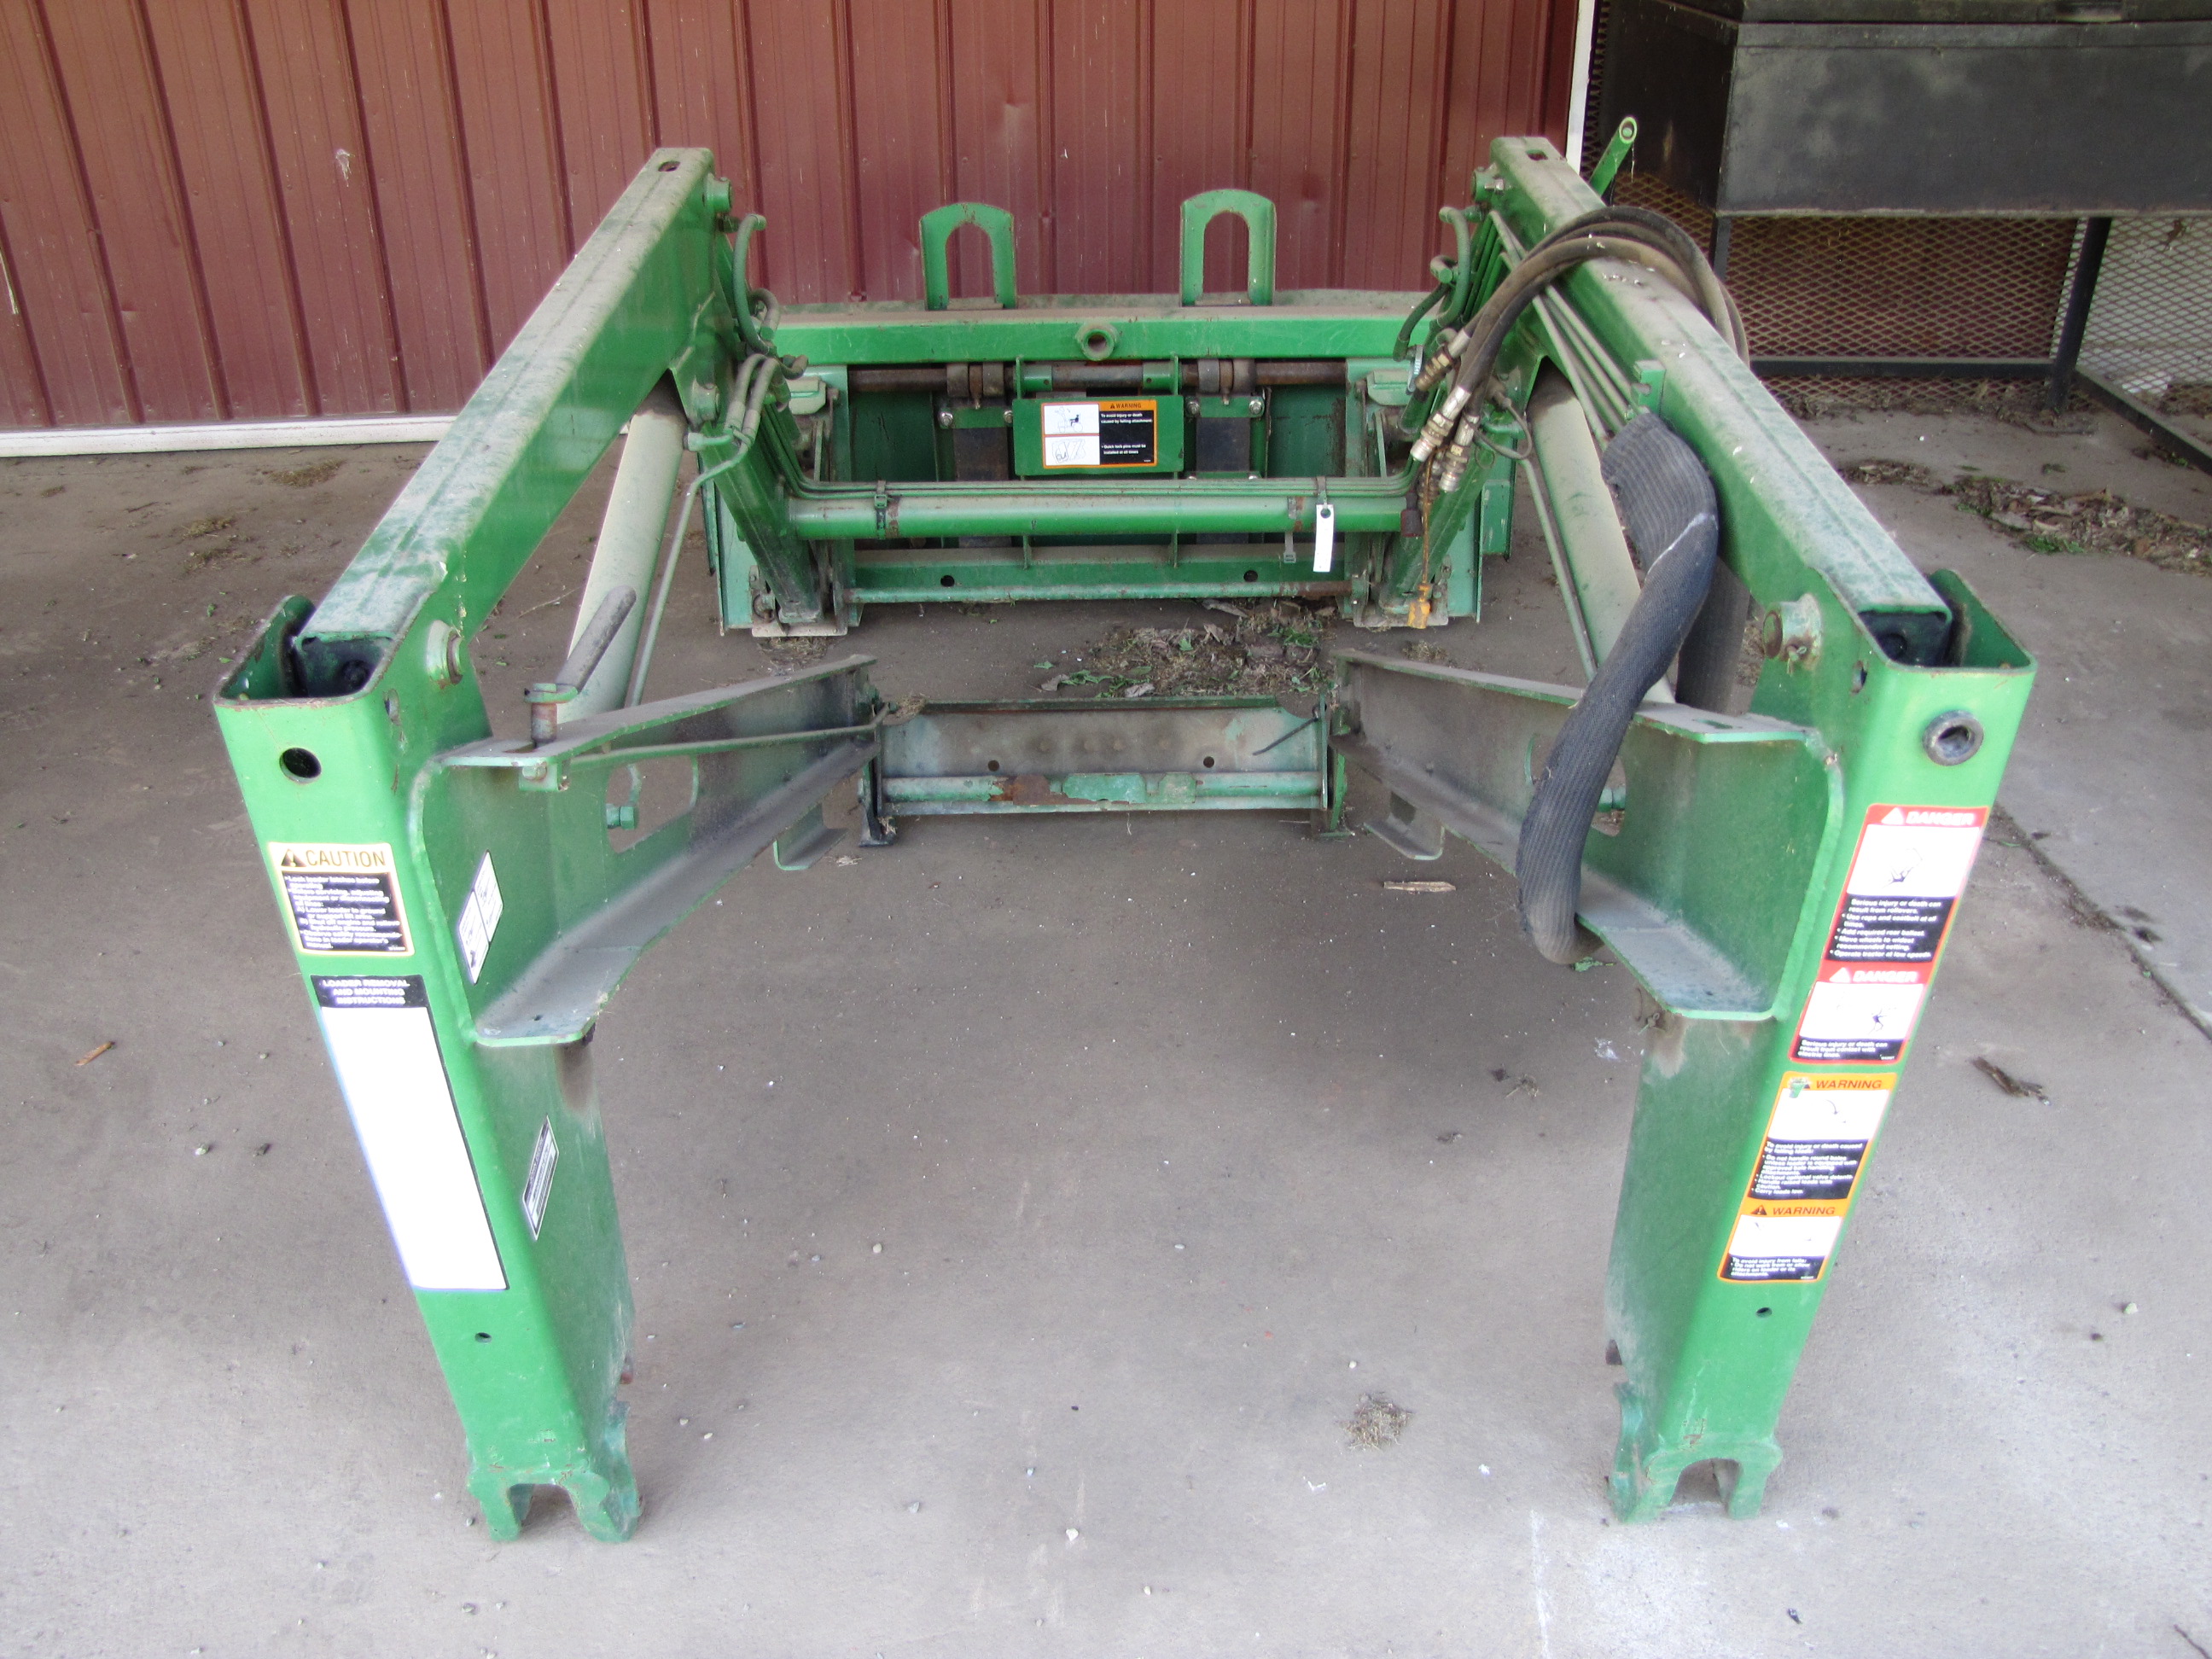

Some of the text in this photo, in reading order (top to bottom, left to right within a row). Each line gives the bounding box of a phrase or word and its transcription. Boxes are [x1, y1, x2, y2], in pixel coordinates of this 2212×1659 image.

[1905, 811, 1976, 826] DANGER
[306, 849, 387, 868] CAUTION
[1852, 970, 1919, 983] DANGER
[323, 979, 410, 987] LOADER REMOVAL
[333, 987, 405, 996] AND MOUNTING
[335, 996, 406, 1004] INSTRUCTIONS
[1816, 1080, 1883, 1089] WARNING
[1773, 1206, 1836, 1215] WARNING
